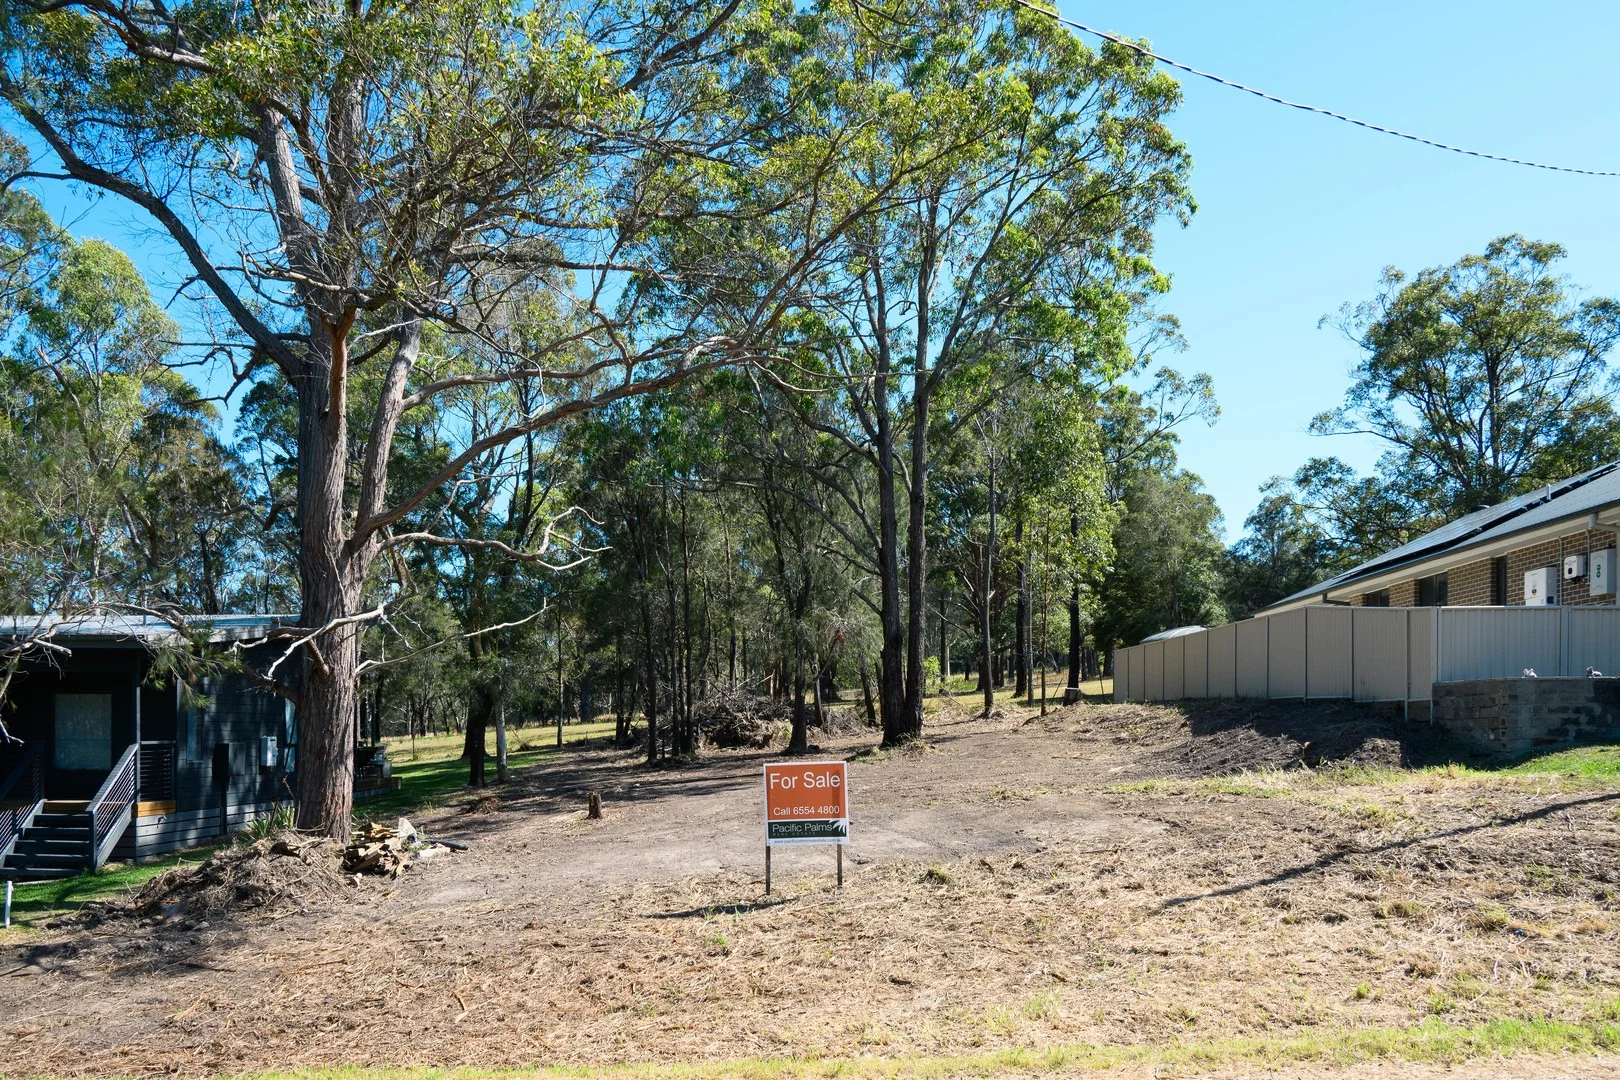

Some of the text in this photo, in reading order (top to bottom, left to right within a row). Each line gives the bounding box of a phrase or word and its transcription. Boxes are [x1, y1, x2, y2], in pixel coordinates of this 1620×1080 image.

[770, 771, 840, 789] For Sale
[773, 805, 840, 815] Call 6554 4800
[772, 823, 832, 832] Pacific Palms
